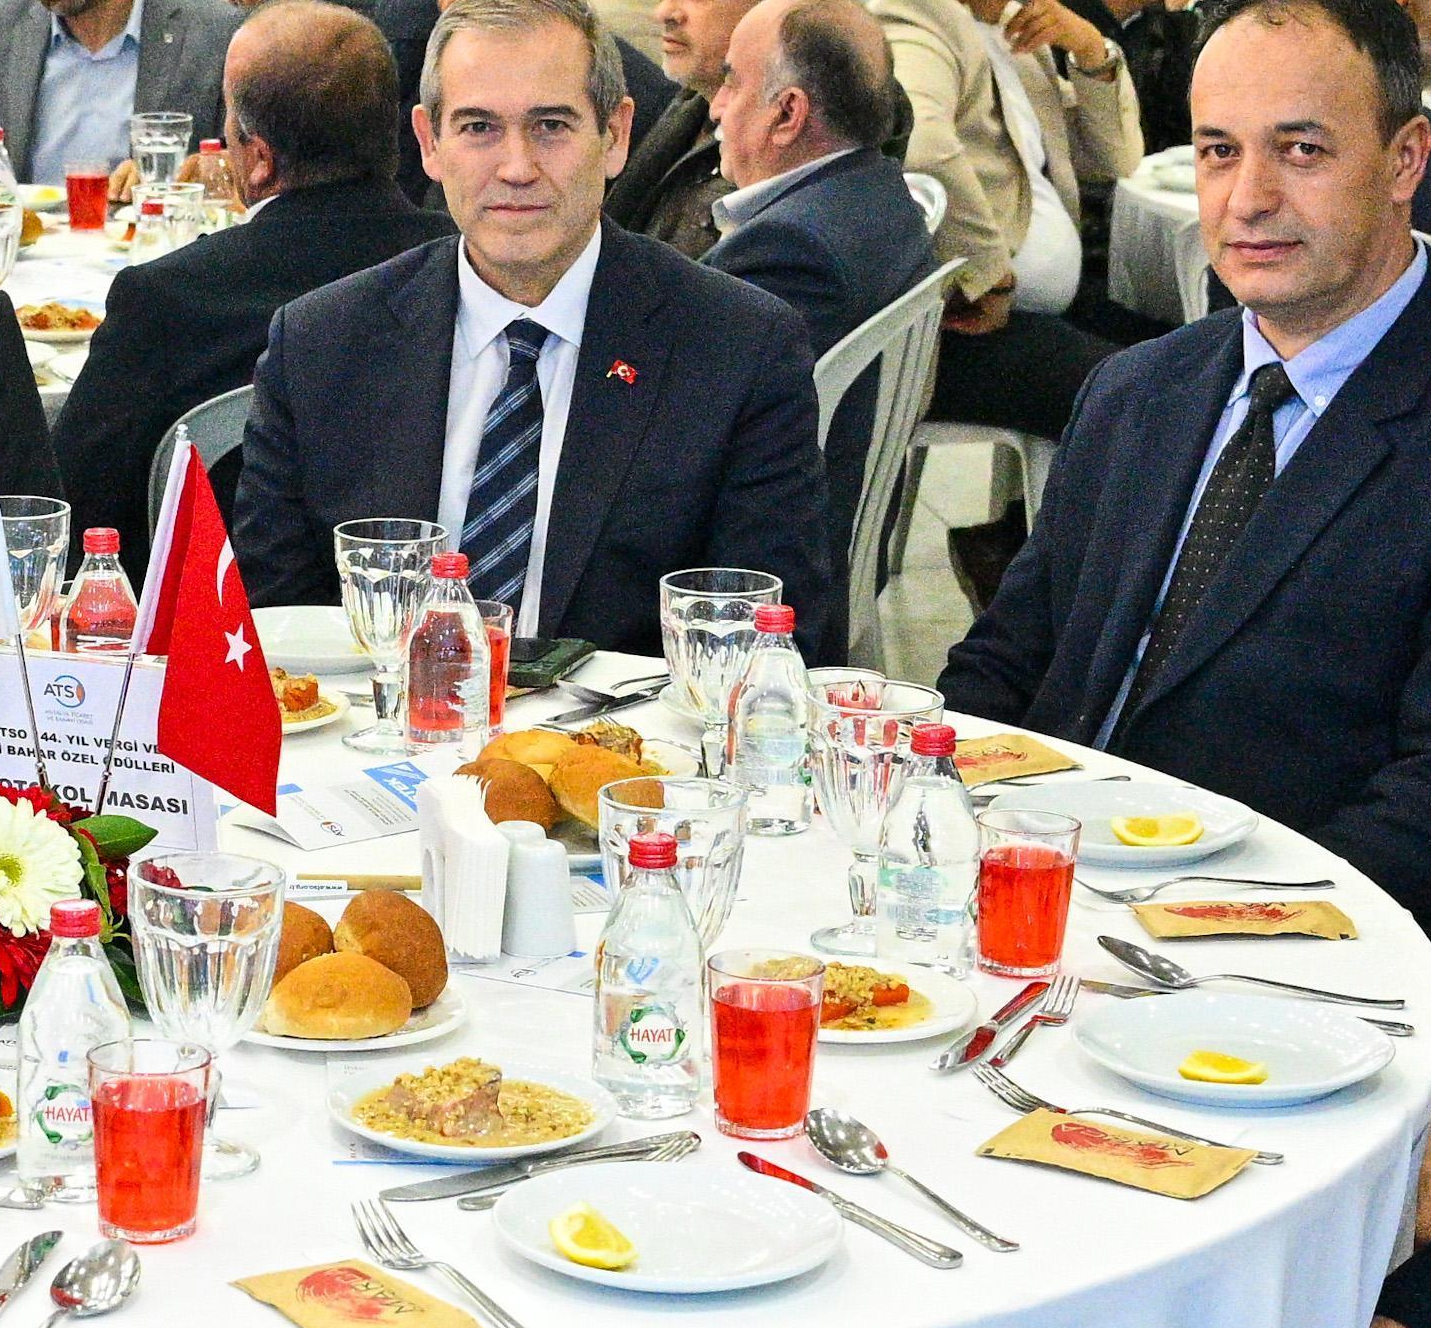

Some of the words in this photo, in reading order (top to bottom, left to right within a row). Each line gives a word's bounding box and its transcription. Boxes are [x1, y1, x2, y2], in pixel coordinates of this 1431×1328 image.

[65, 734, 90, 747] YIL
[93, 737, 138, 752] VERGİ
[7, 745, 57, 761] BAHAR
[60, 747, 99, 766] ÖZEL
[629, 1027, 675, 1043] HAYAT
[44, 1105, 93, 1122] HAYAT
